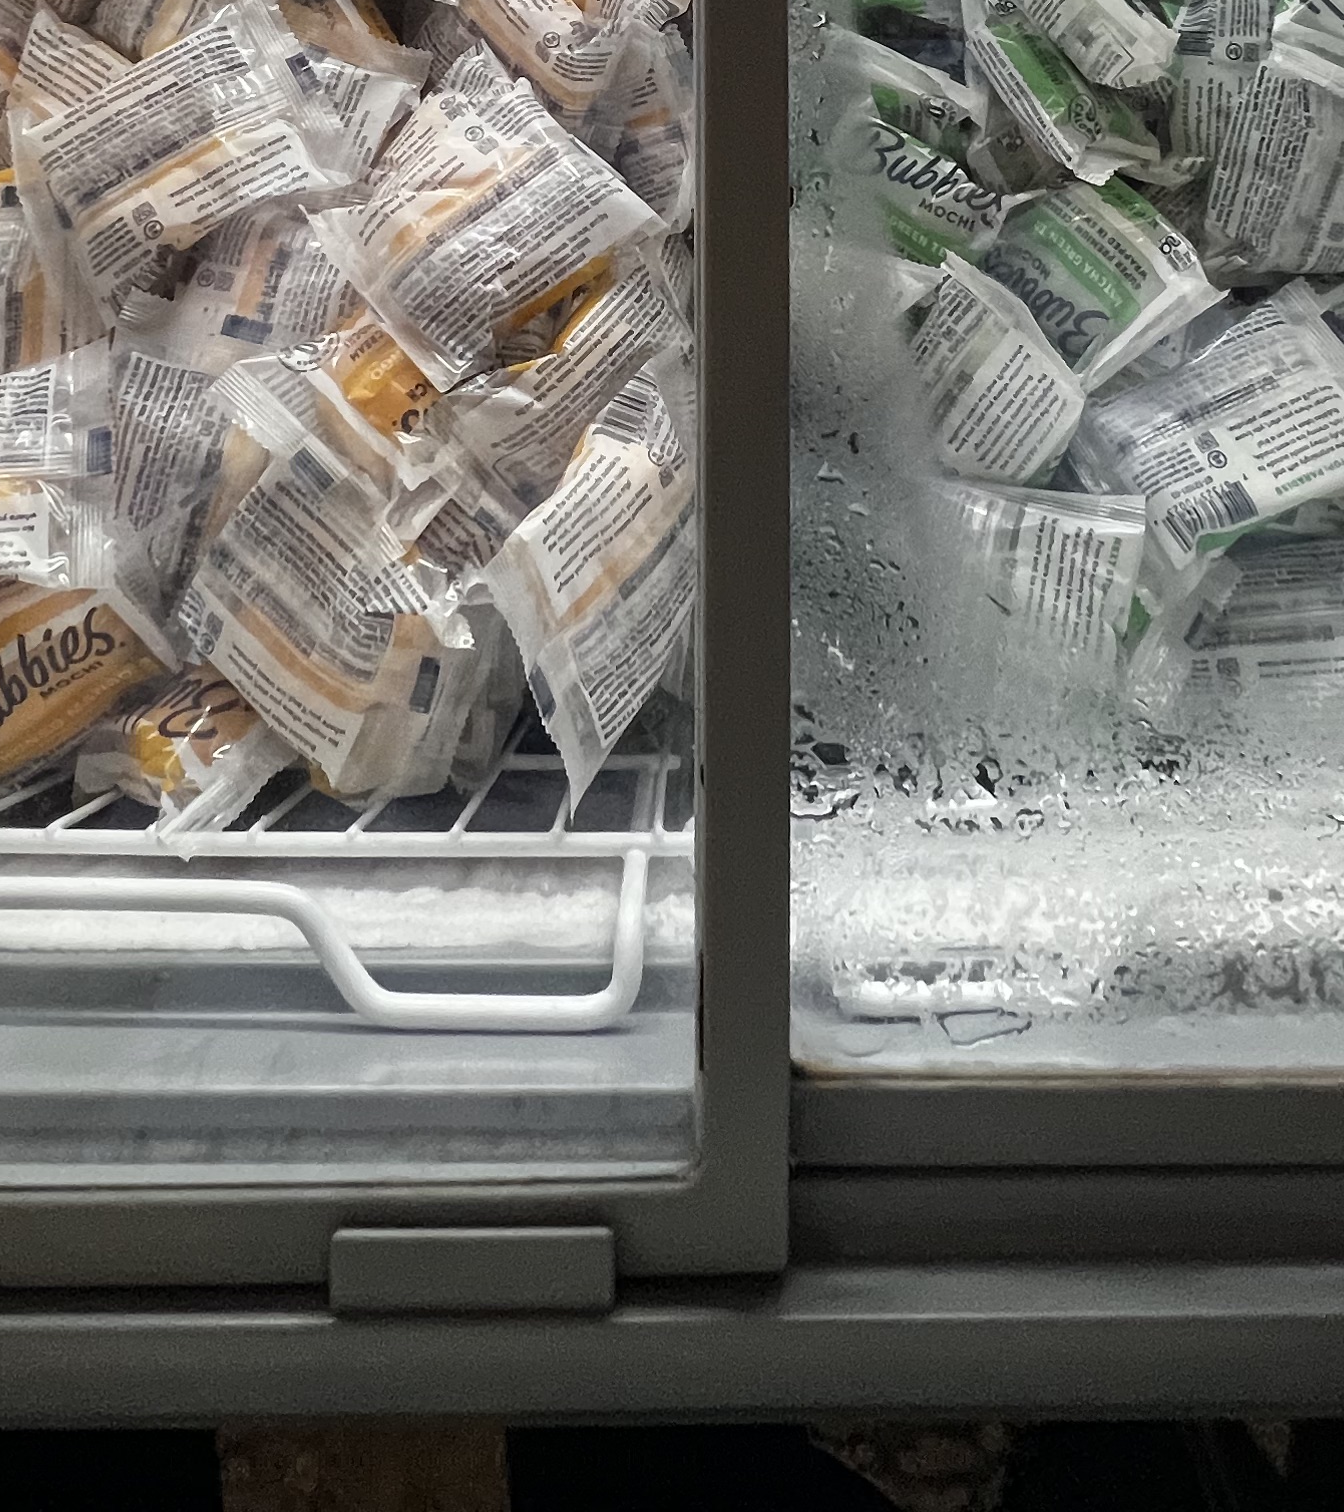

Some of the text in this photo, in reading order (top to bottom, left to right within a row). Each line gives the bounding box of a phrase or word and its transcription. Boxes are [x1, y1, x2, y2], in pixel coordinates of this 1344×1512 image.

[919, 199, 976, 232] MOCHI
[1047, 229, 1085, 266] GREEN
[1104, 236, 1152, 281] WRAPPED
[1112, 260, 1145, 291] SUPER
[40, 660, 105, 699] MOCHI
